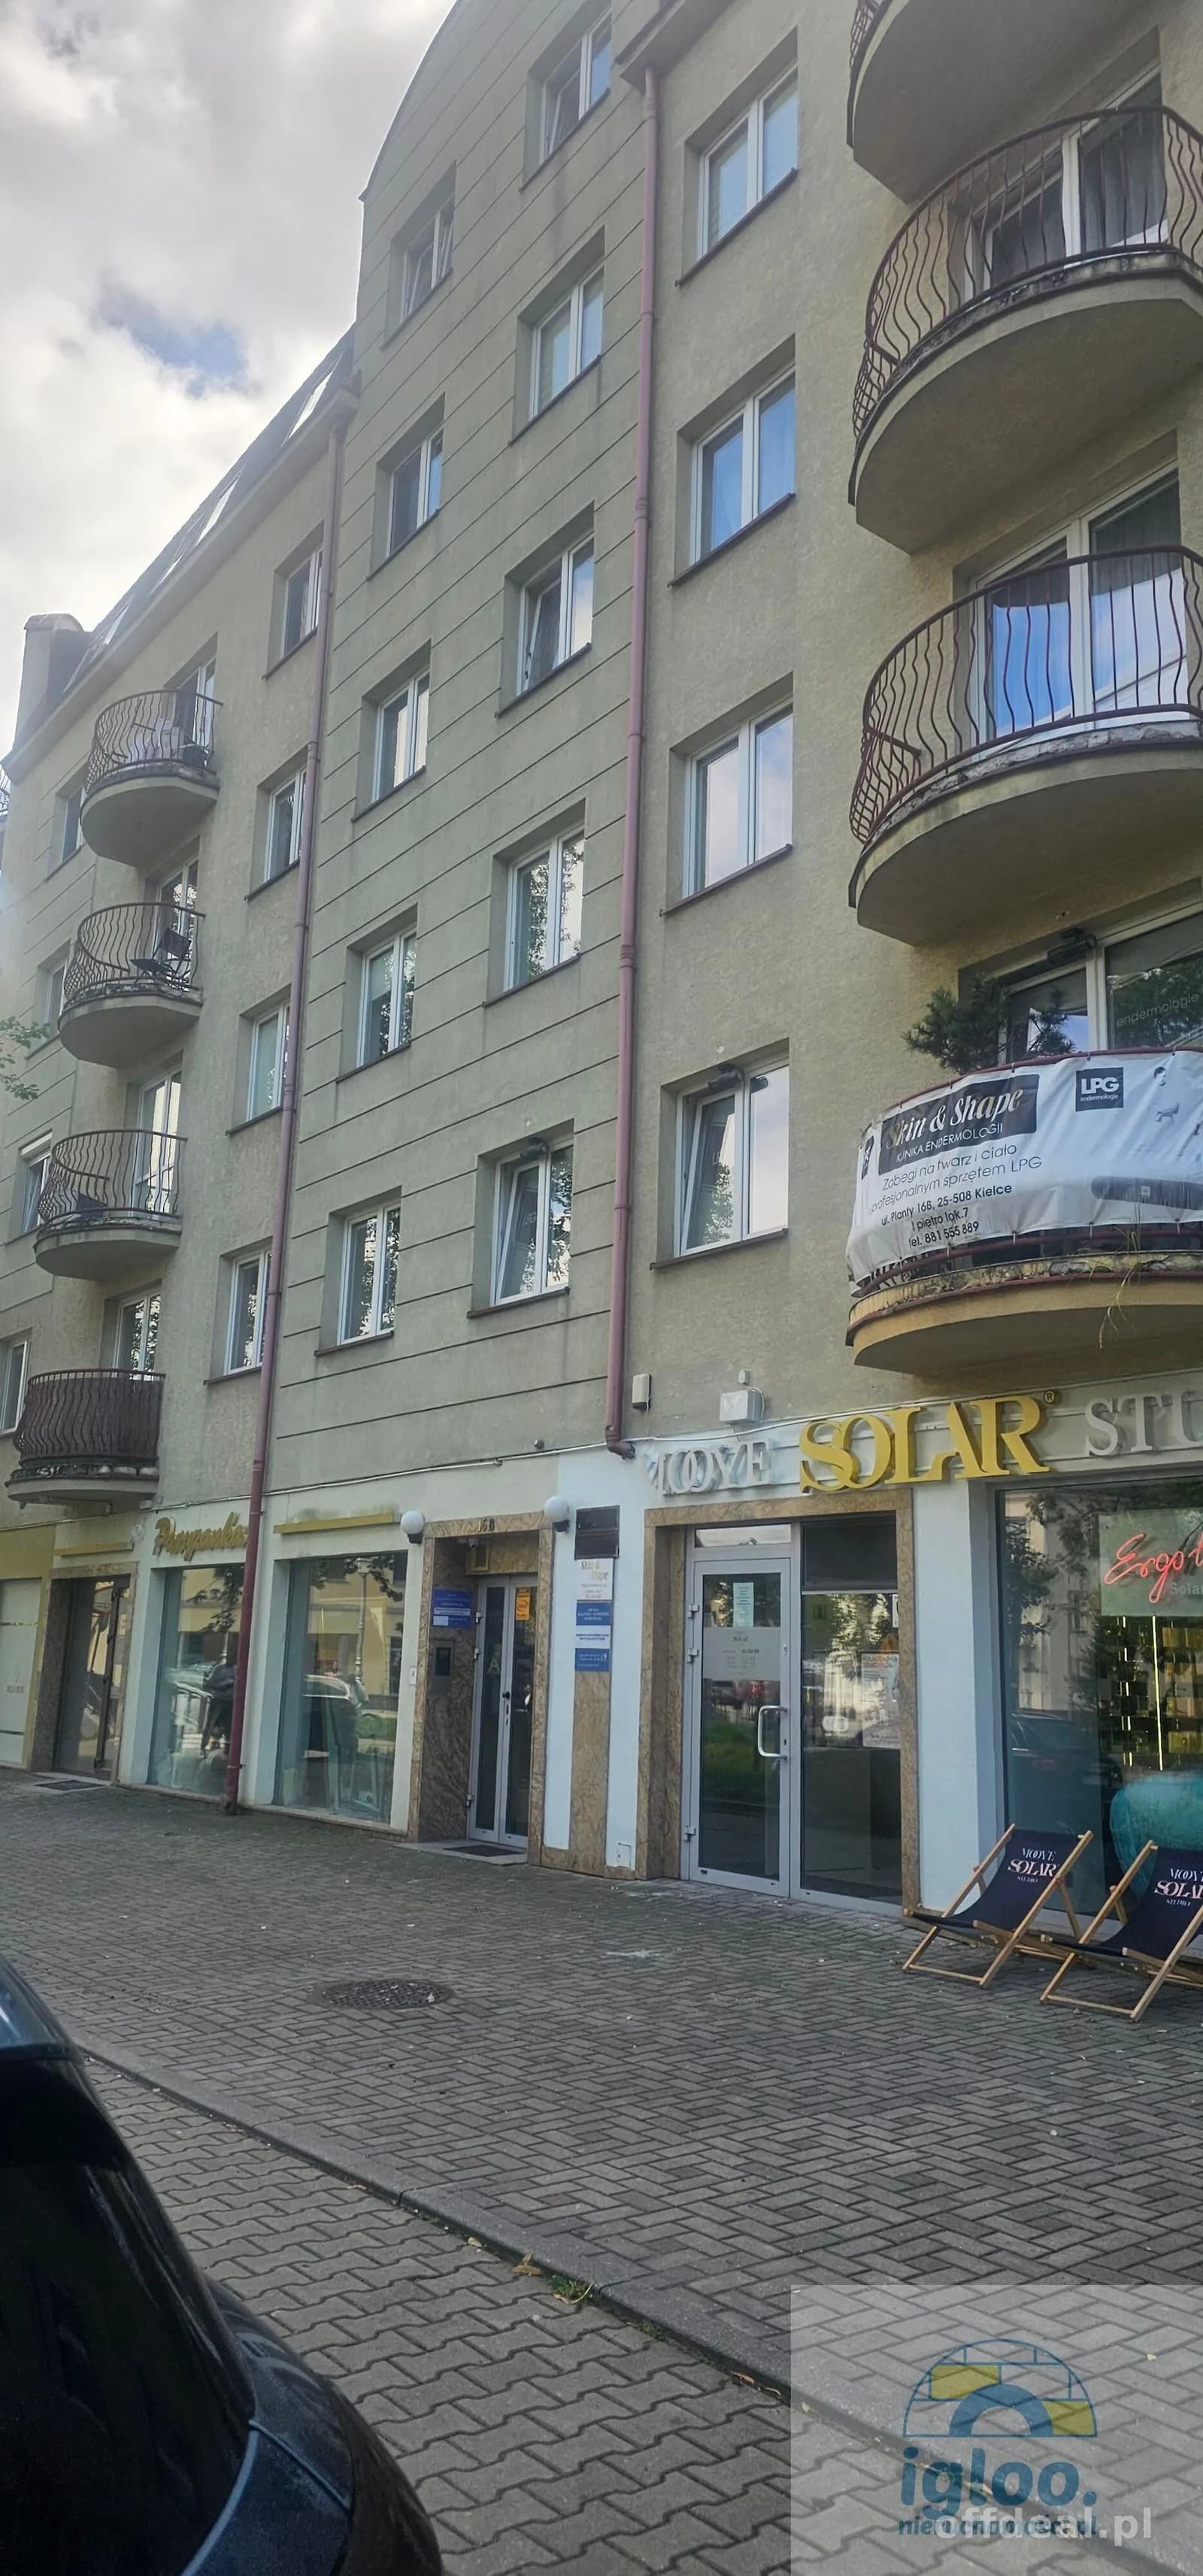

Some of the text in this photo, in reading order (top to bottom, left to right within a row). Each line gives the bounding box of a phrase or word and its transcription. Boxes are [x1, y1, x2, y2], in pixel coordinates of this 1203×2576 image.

[1117, 993, 1199, 1027] endermologie
[1080, 1077, 1120, 1095] LPG
[1080, 1093, 1119, 1102] endermologie
[886, 1089, 1023, 1149] Skin & Shape
[926, 1123, 1003, 1151] ENDERMOLOGII
[883, 1167, 917, 1190] Zabiegi
[920, 1165, 935, 1177] na
[937, 1154, 971, 1171] twarz
[981, 1143, 1017, 1160] ciało
[943, 1163, 1005, 1187] sprzętem
[1011, 1156, 1042, 1172] LPG
[882, 1214, 890, 1226] ul.
[891, 1206, 914, 1223] Planty
[938, 1187, 972, 1208] 25-508
[975, 1183, 1013, 1199] Kielce
[909, 1220, 980, 1249] tel. 881 555 889
[478, 1517, 495, 1532] 16B
[1008, 1859, 1057, 1877] SOLAR
